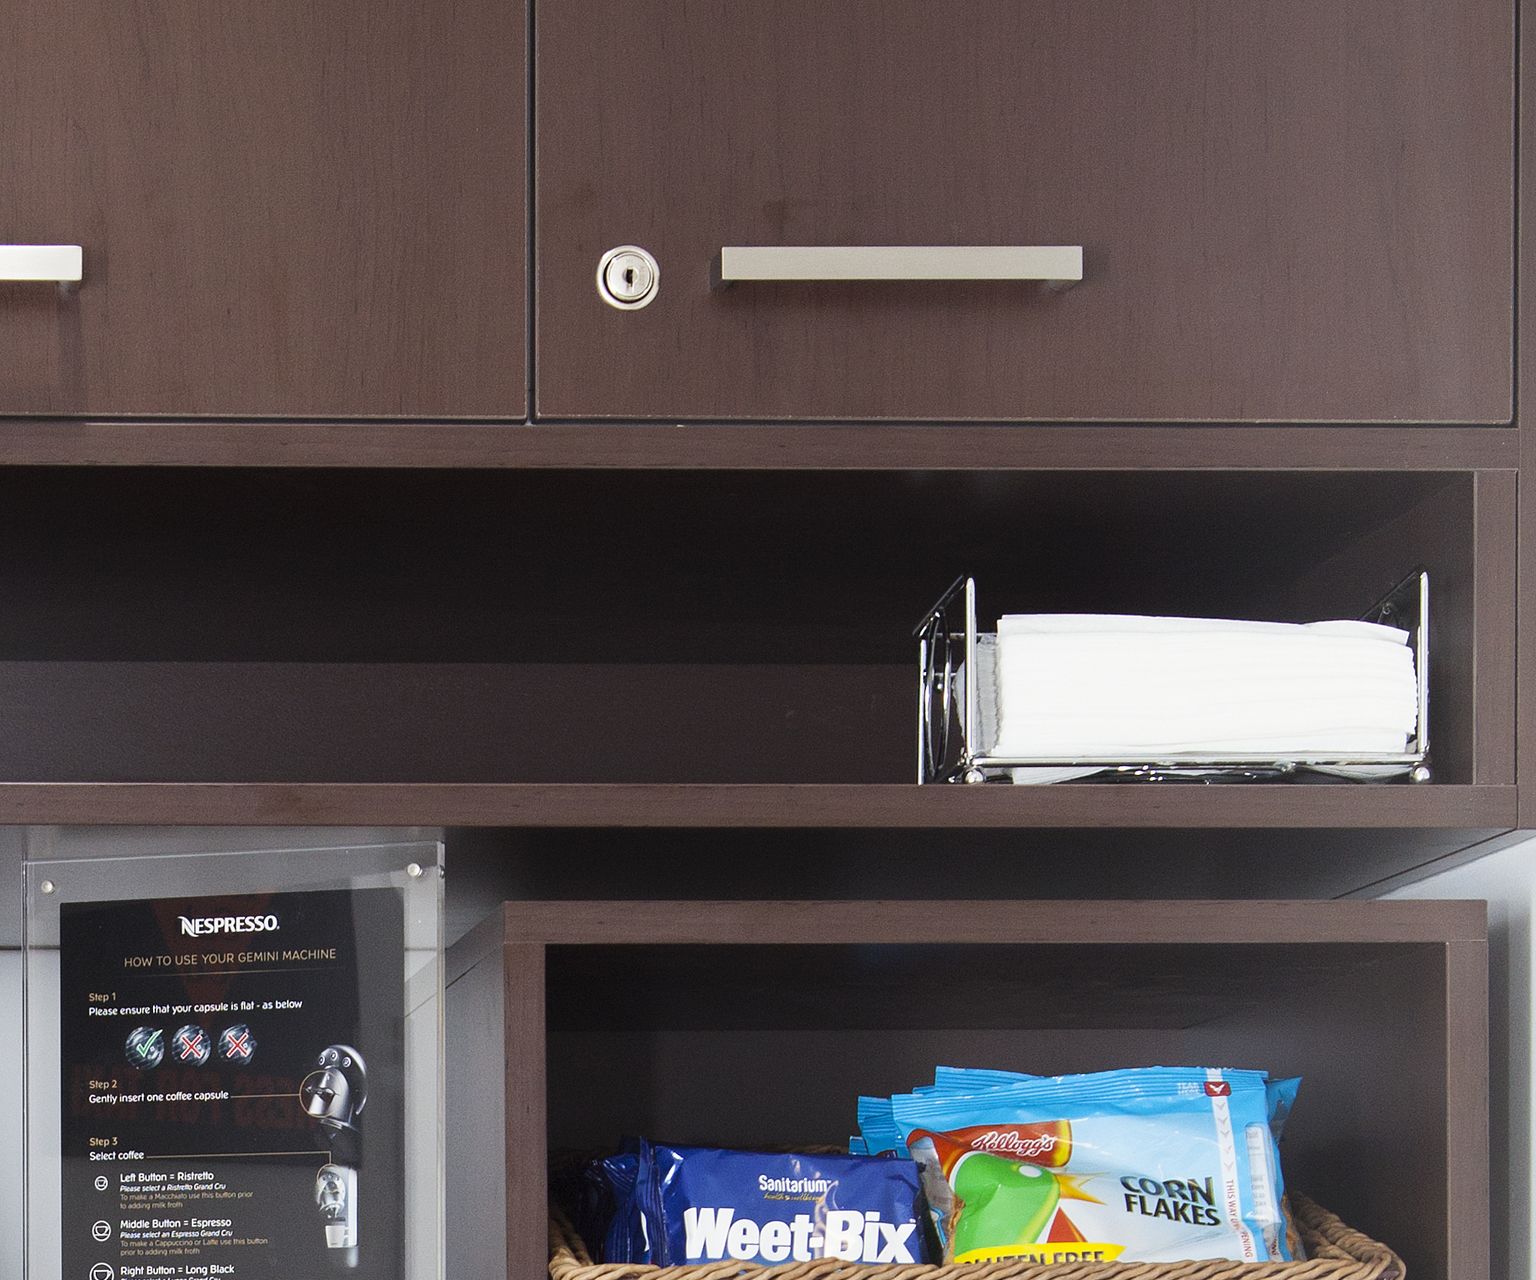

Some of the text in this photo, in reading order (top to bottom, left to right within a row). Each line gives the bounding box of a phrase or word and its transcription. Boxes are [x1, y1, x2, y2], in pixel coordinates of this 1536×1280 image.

[124, 949, 336, 968] HOW TO USE YOUR GEMINI MACHINE
[88, 993, 109, 1002] Step
[88, 1000, 302, 1016] Please ensure that your capsule is flat as below
[89, 1080, 117, 1090] Step 2
[89, 1091, 229, 1105] Gently insert one coffee capsule
[89, 1137, 118, 1147] Step 3
[971, 1131, 1056, 1157] Kellogg's
[89, 1151, 144, 1161] Select coffee
[120, 1172, 214, 1182] Left Button Ristretto
[759, 1175, 828, 1192] Sanitarium
[120, 1184, 140, 1192] Please
[167, 1183, 193, 1191] Ristretto
[1120, 1176, 1216, 1206] CORN
[1226, 1179, 1236, 1218] THIS WAY
[1124, 1193, 1221, 1226] FLAKES
[120, 1219, 231, 1229] Middle Button Espresso
[120, 1231, 141, 1239] Please
[142, 1230, 160, 1238] select
[172, 1230, 199, 1238] Espresso
[684, 1207, 917, 1263] Weet-Bix
[121, 1264, 234, 1277] Right Button Long Black
